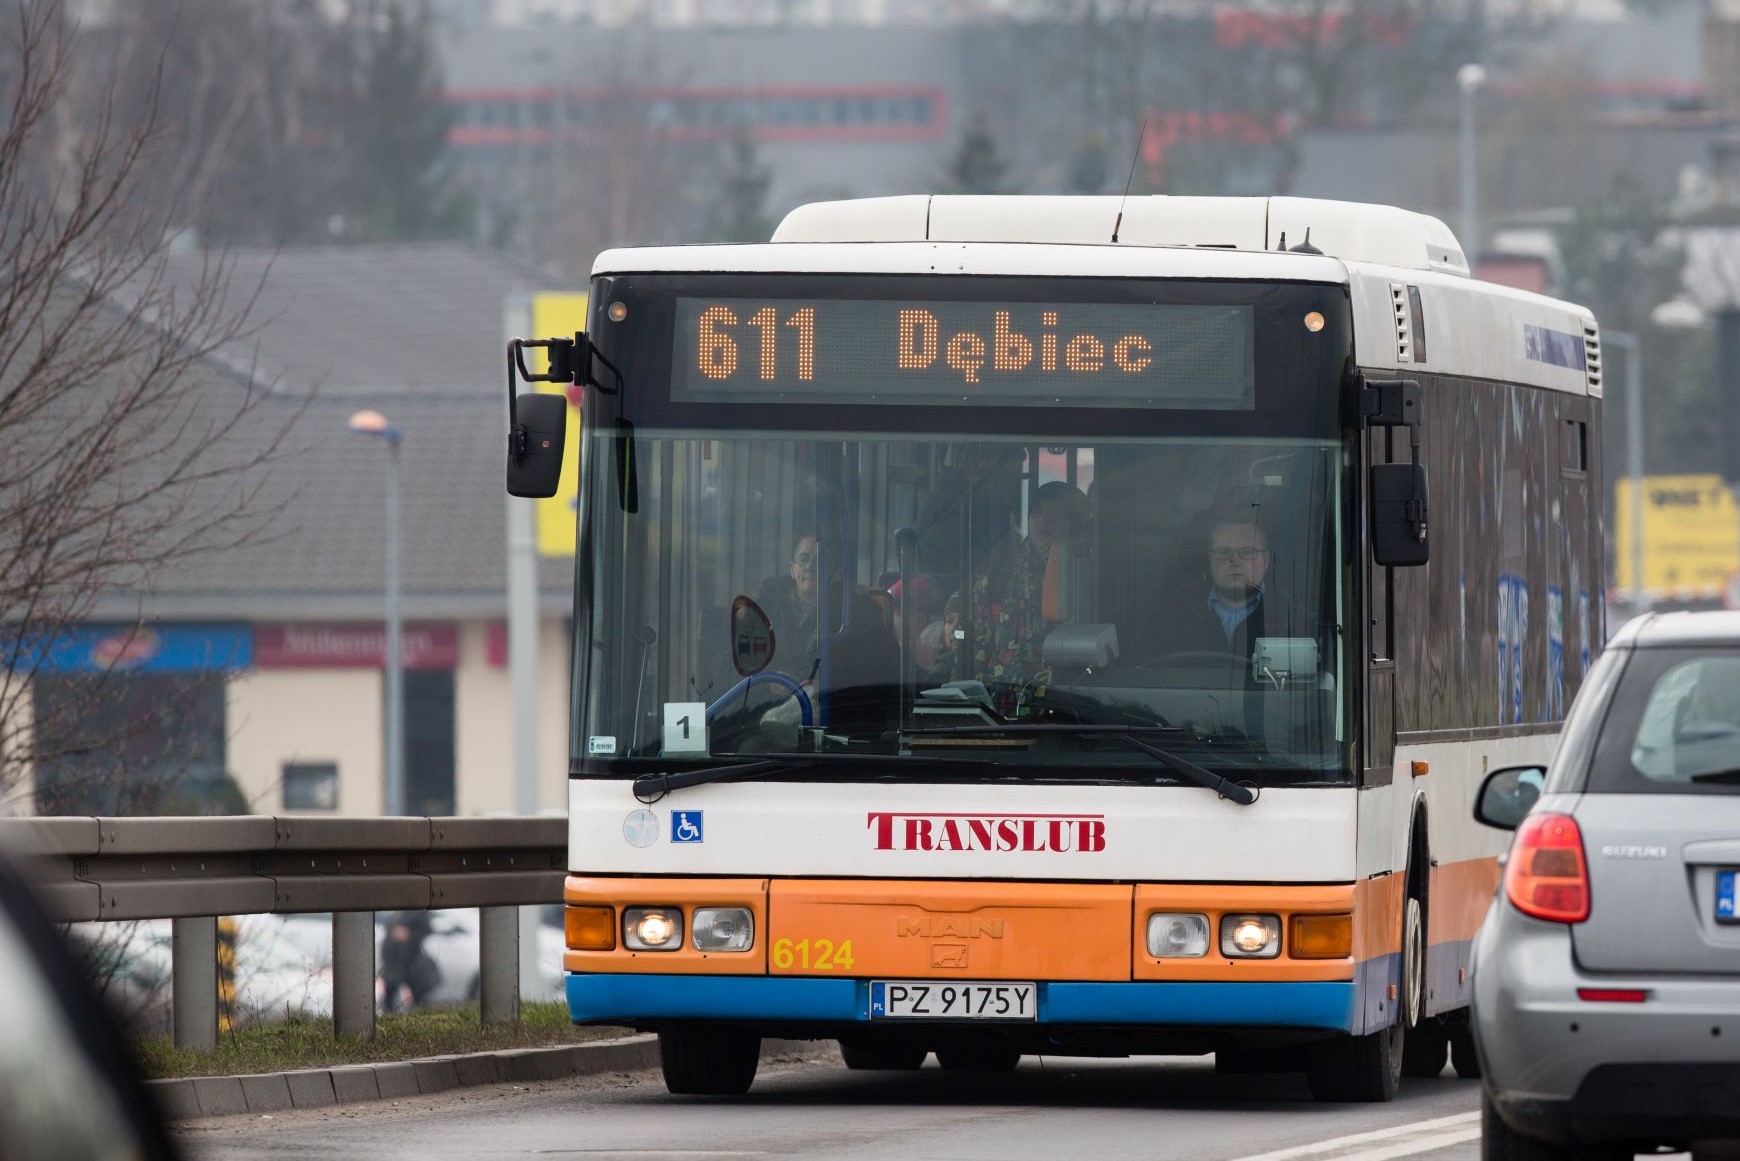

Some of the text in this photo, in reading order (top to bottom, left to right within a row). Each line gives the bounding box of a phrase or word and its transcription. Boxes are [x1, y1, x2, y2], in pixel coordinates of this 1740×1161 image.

[698, 306, 1152, 383] 611 Dębiec
[676, 715, 690, 739] 1
[867, 812, 1106, 853] TRANSLUB
[1602, 845, 1667, 859] SUZUKI
[896, 916, 1004, 939] MAN
[773, 937, 855, 970] 6124
[873, 986, 1030, 1015] PL PZ 9175Y
